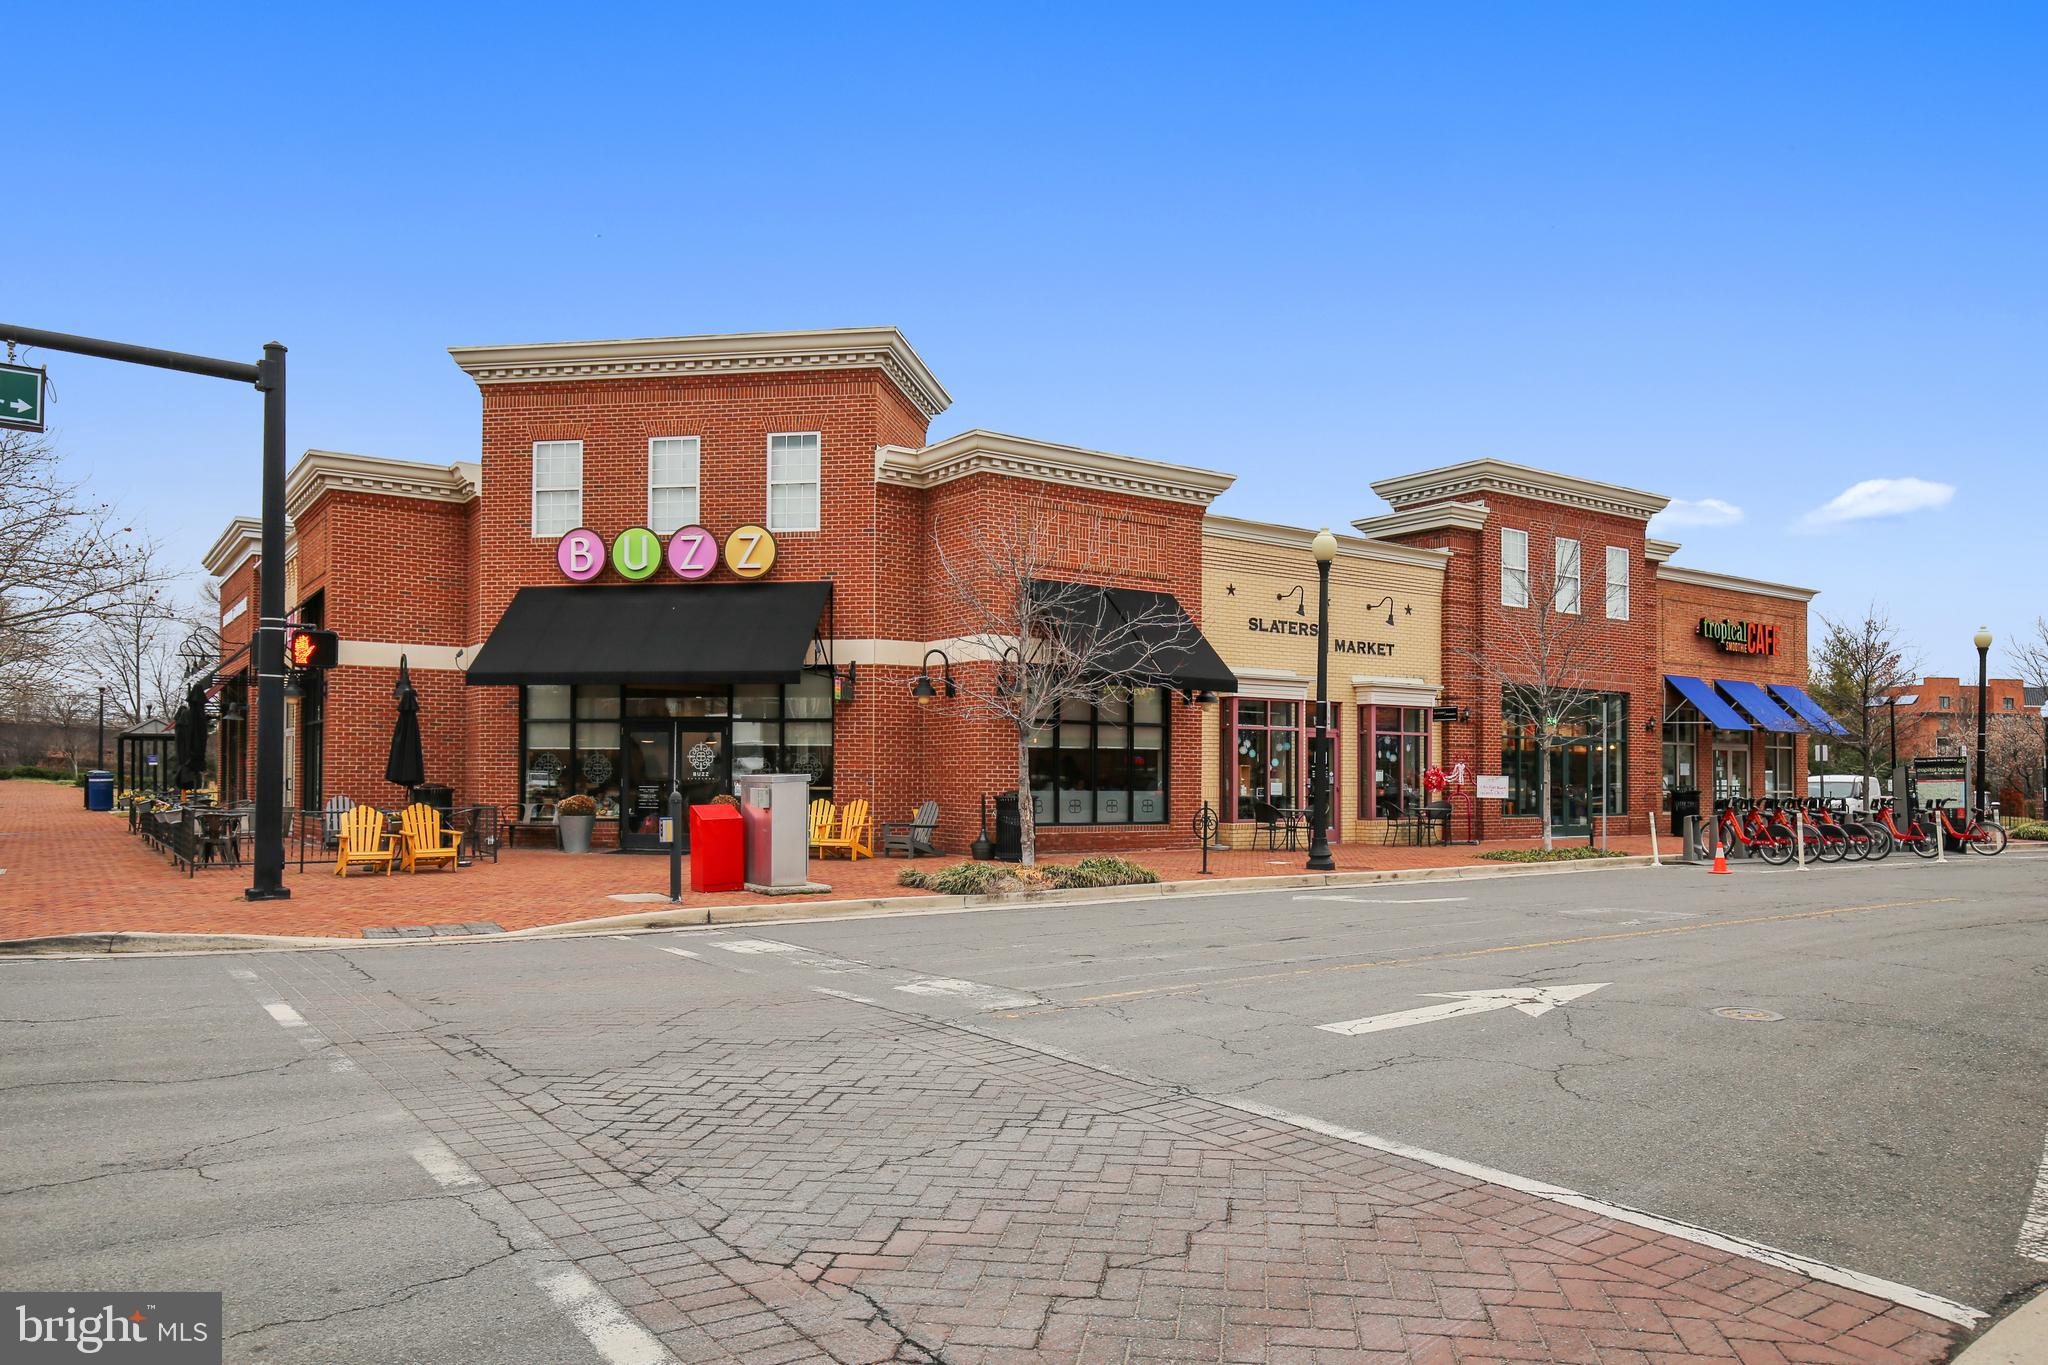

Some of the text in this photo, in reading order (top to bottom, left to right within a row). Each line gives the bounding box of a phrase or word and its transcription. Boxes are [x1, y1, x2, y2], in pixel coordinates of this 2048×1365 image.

[570, 534, 762, 572] BUZZ
[1248, 617, 1319, 636] SLATERS
[1703, 618, 1781, 656] tropical CAFE
[1334, 639, 1395, 656] MARKET
